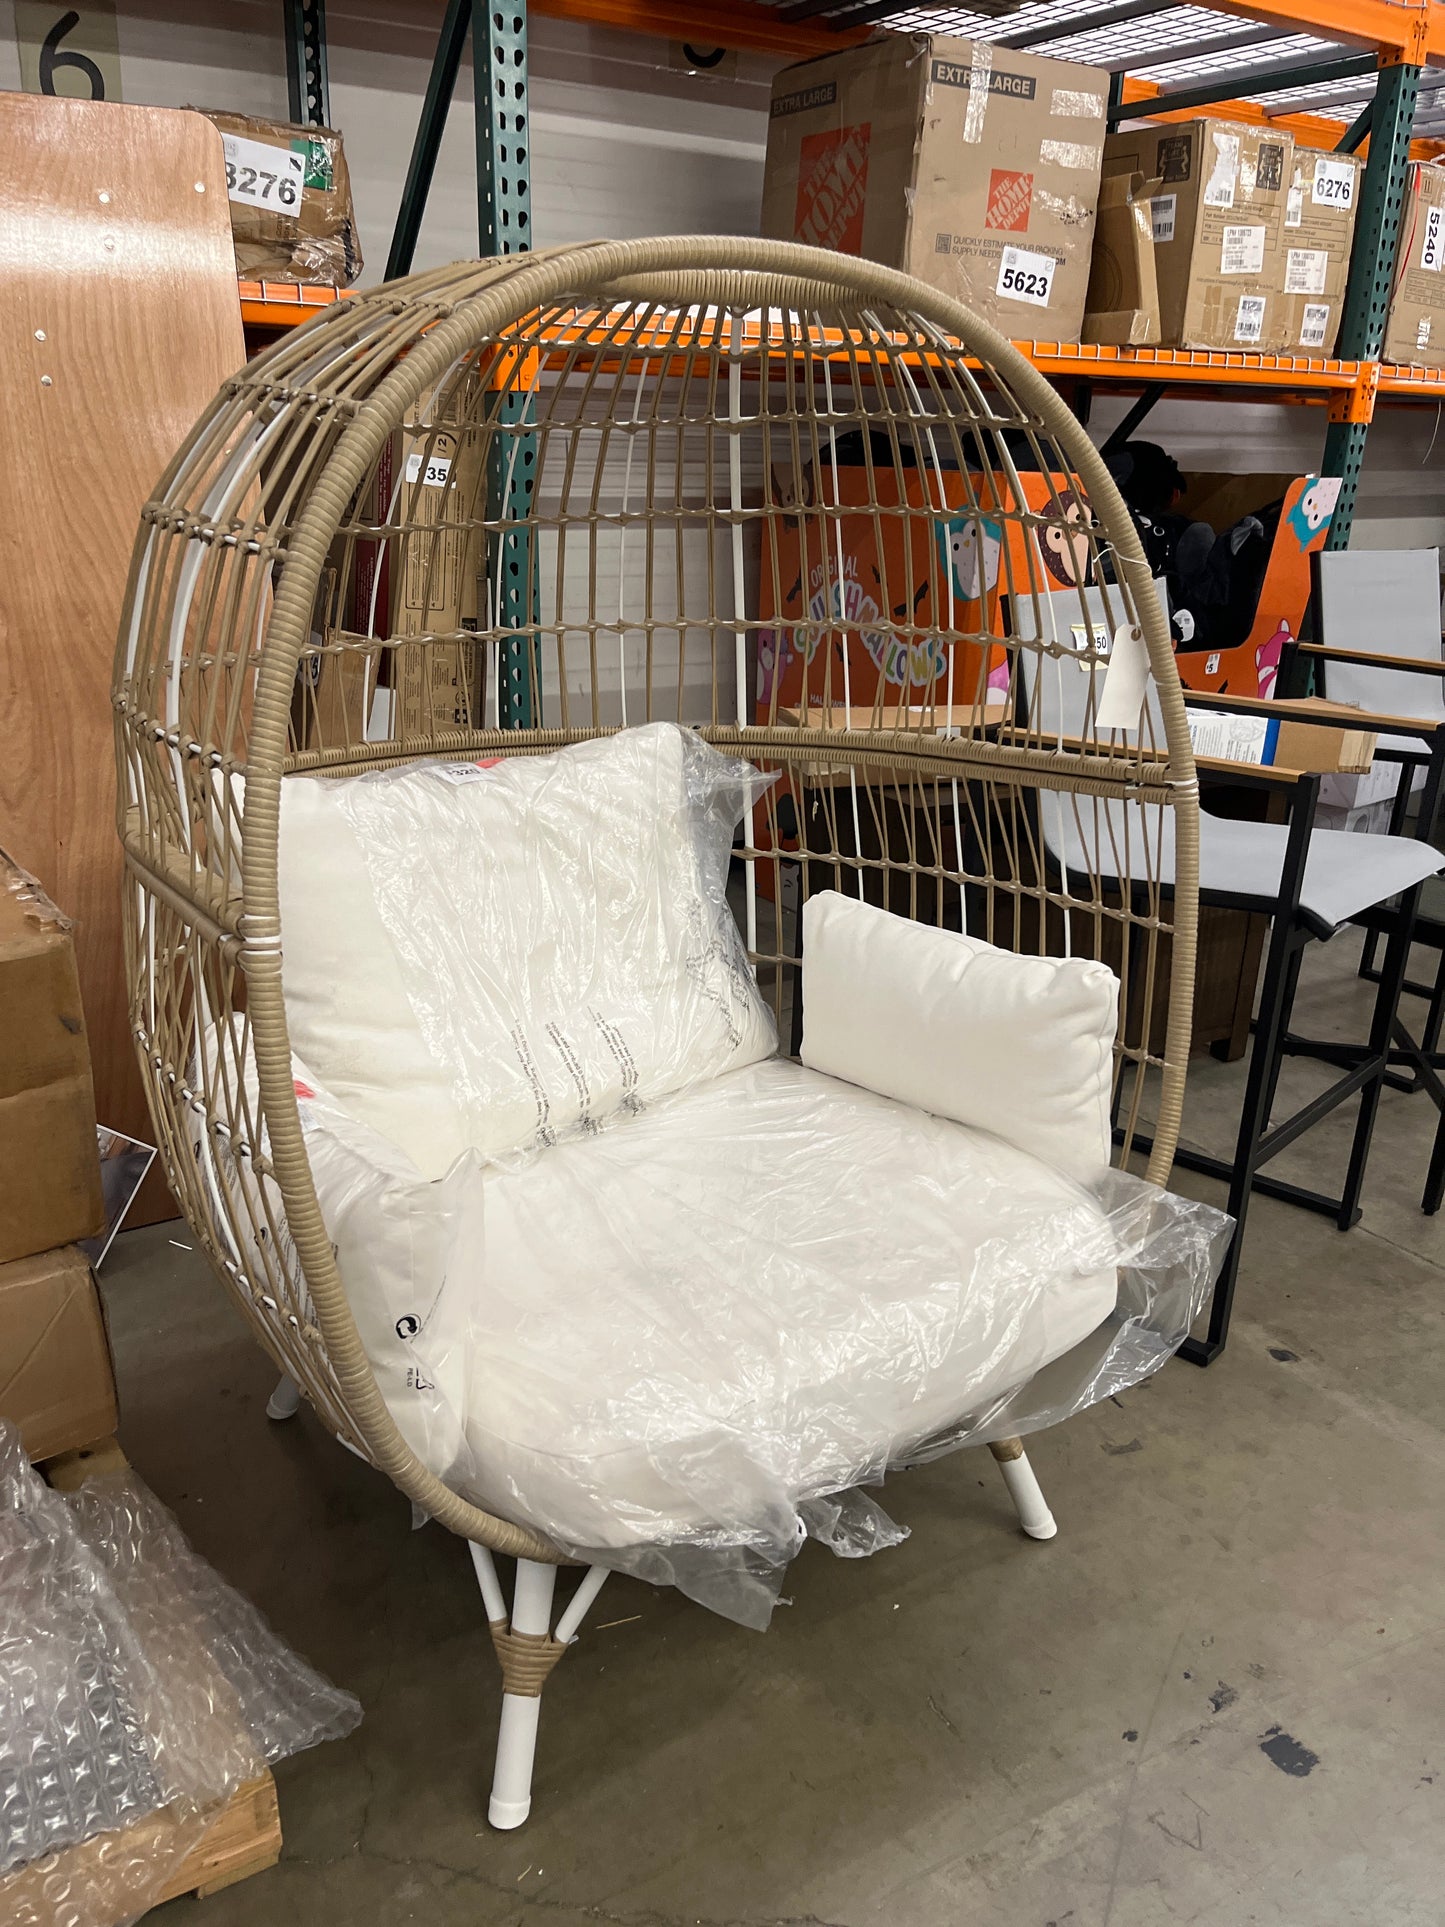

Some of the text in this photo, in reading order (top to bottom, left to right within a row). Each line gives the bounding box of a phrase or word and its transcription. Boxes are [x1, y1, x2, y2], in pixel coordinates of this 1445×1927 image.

[936, 64, 987, 88] EXTR
[773, 86, 834, 115] EXTRA LARGE
[986, 174, 1033, 229] HOME
[993, 177, 1012, 199] THE
[1316, 177, 1351, 201] 6276
[1003, 197, 1031, 230] DEPOT
[952, 246, 979, 256] SUPPLY
[953, 236, 984, 247] QUICKLY
[1423, 211, 1442, 266] 5240
[1002, 268, 1049, 298] 5623
[811, 556, 859, 587] ORGIAL
